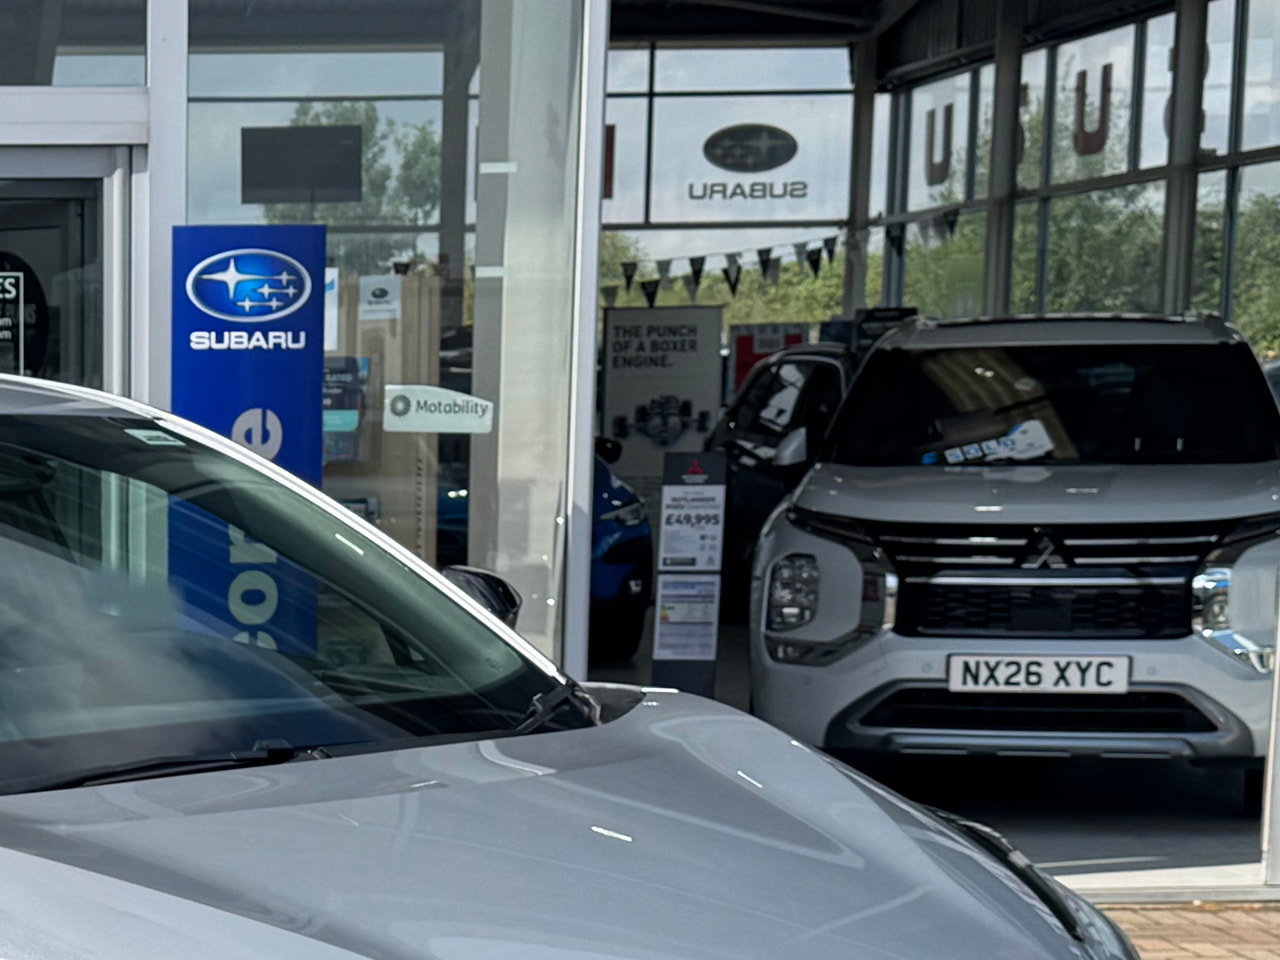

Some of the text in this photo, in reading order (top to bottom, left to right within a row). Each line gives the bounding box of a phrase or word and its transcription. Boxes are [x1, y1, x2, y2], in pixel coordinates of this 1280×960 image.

[189, 330, 307, 351] SUBARU
[612, 324, 698, 339] THE PUNCH
[611, 338, 698, 353] OF A BOXER
[415, 399, 490, 419] Motability
[961, 660, 1115, 688] NX26 XYC
